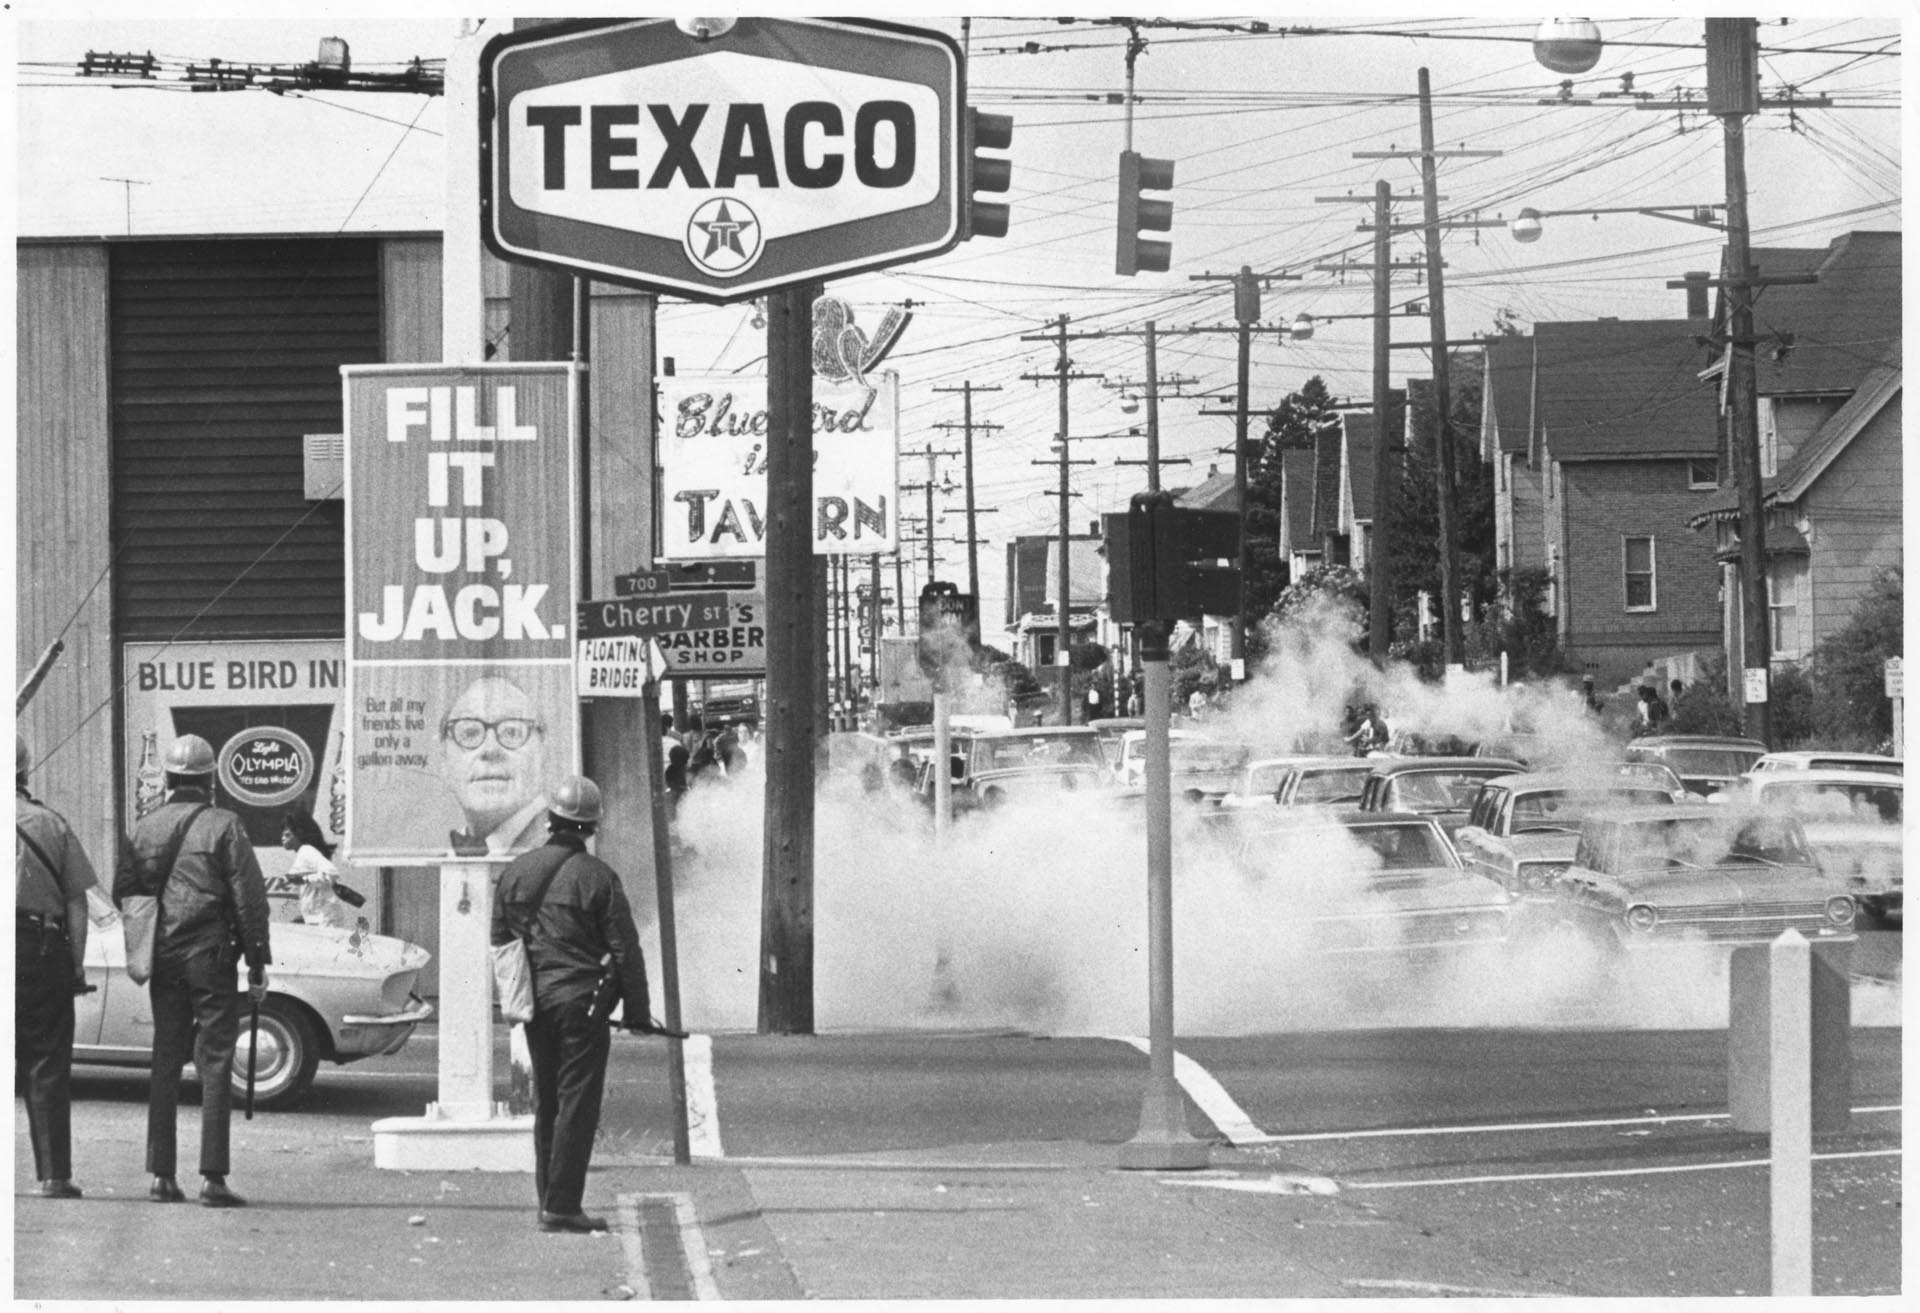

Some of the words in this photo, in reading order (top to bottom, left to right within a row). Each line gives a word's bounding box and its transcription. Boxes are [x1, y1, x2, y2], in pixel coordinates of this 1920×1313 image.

[526, 99, 917, 190] TEXACO
[386, 386, 537, 442] FILL
[675, 392, 769, 439] Blue
[428, 452, 496, 506] IT
[673, 489, 887, 544] TAVRN
[414, 517, 513, 580] UP,
[627, 577, 657, 591] 700
[358, 584, 566, 642] JACK.
[602, 603, 692, 629] Cherry
[678, 649, 744, 664] SHOP
[138, 661, 216, 691] BLUE
[227, 660, 298, 690] BIRD
[309, 659, 347, 688] IN
[589, 667, 639, 689] BRIDGE
[366, 697, 386, 713] But
[390, 697, 403, 713] all
[407, 700, 427, 715] my
[362, 715, 402, 731] friends
[405, 714, 425, 731] live
[374, 733, 400, 751] only
[402, 736, 411, 748] a
[231, 752, 300, 776] OLYMPIA
[357, 751, 393, 770] gallon
